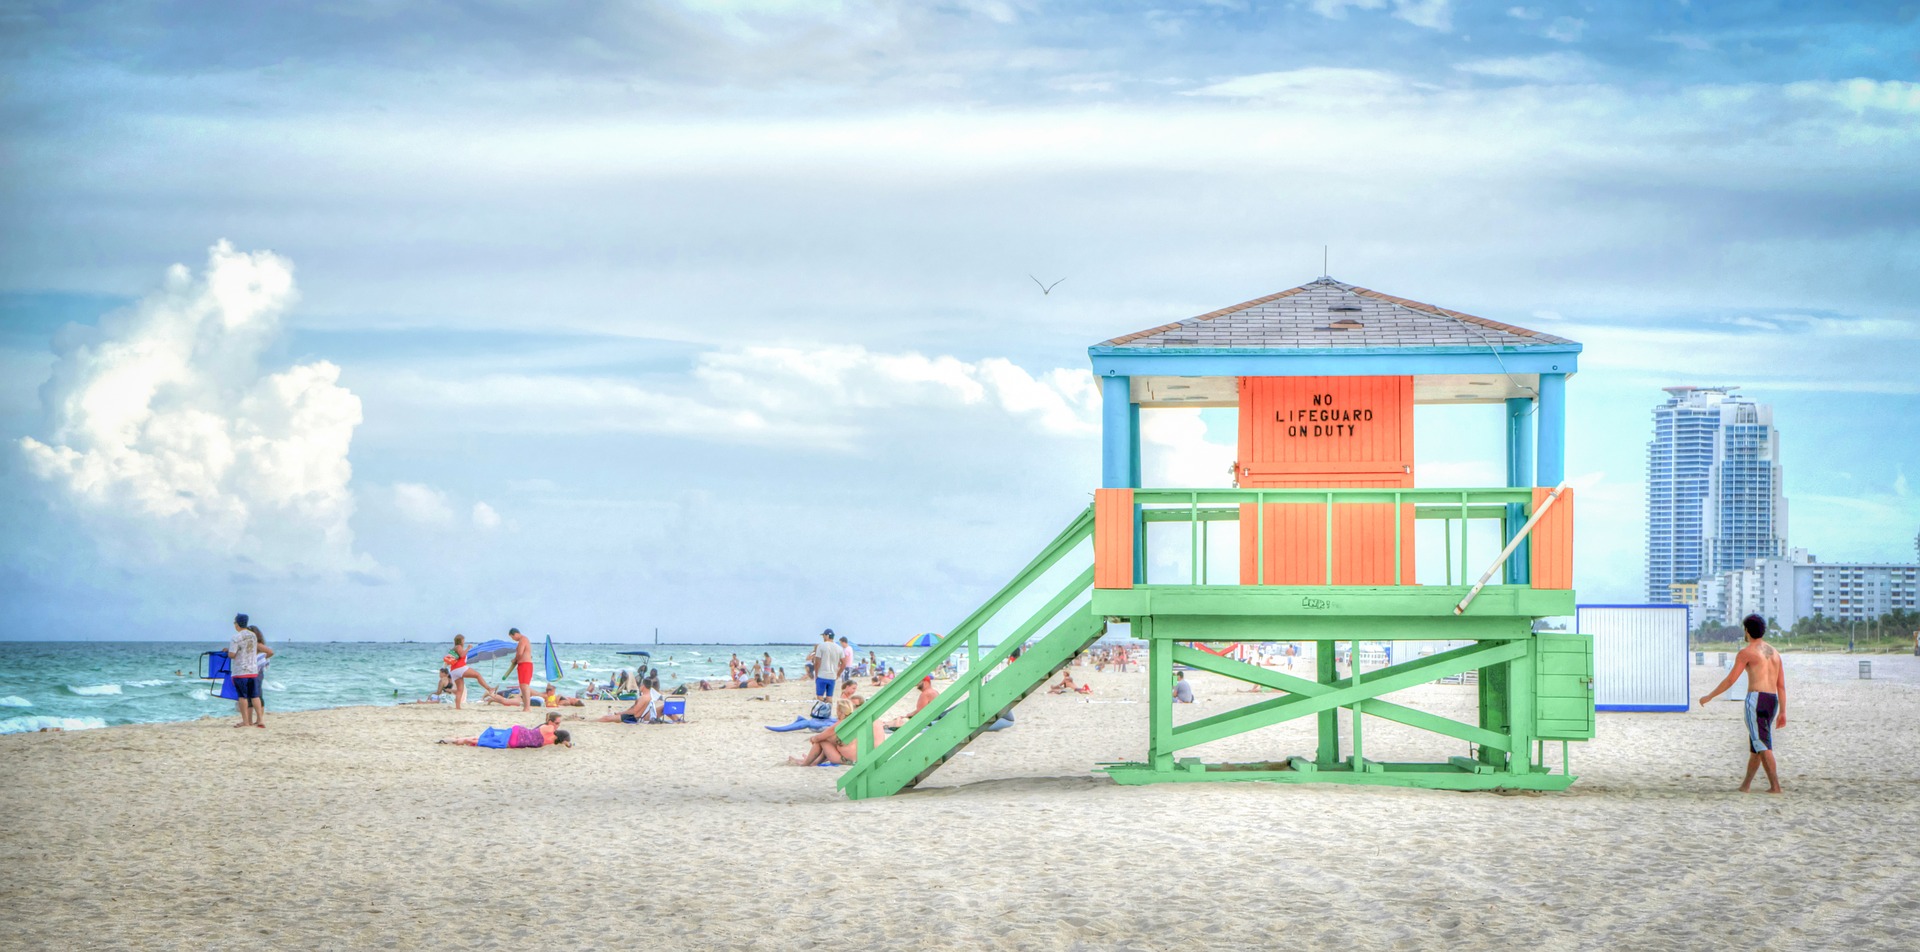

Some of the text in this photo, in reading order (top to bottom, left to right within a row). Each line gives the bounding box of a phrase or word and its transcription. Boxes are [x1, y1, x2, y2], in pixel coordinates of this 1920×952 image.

[1313, 394, 1332, 406] NO
[1276, 409, 1373, 422] LIFEGUARD
[1288, 425, 1355, 437] ON DUTY
